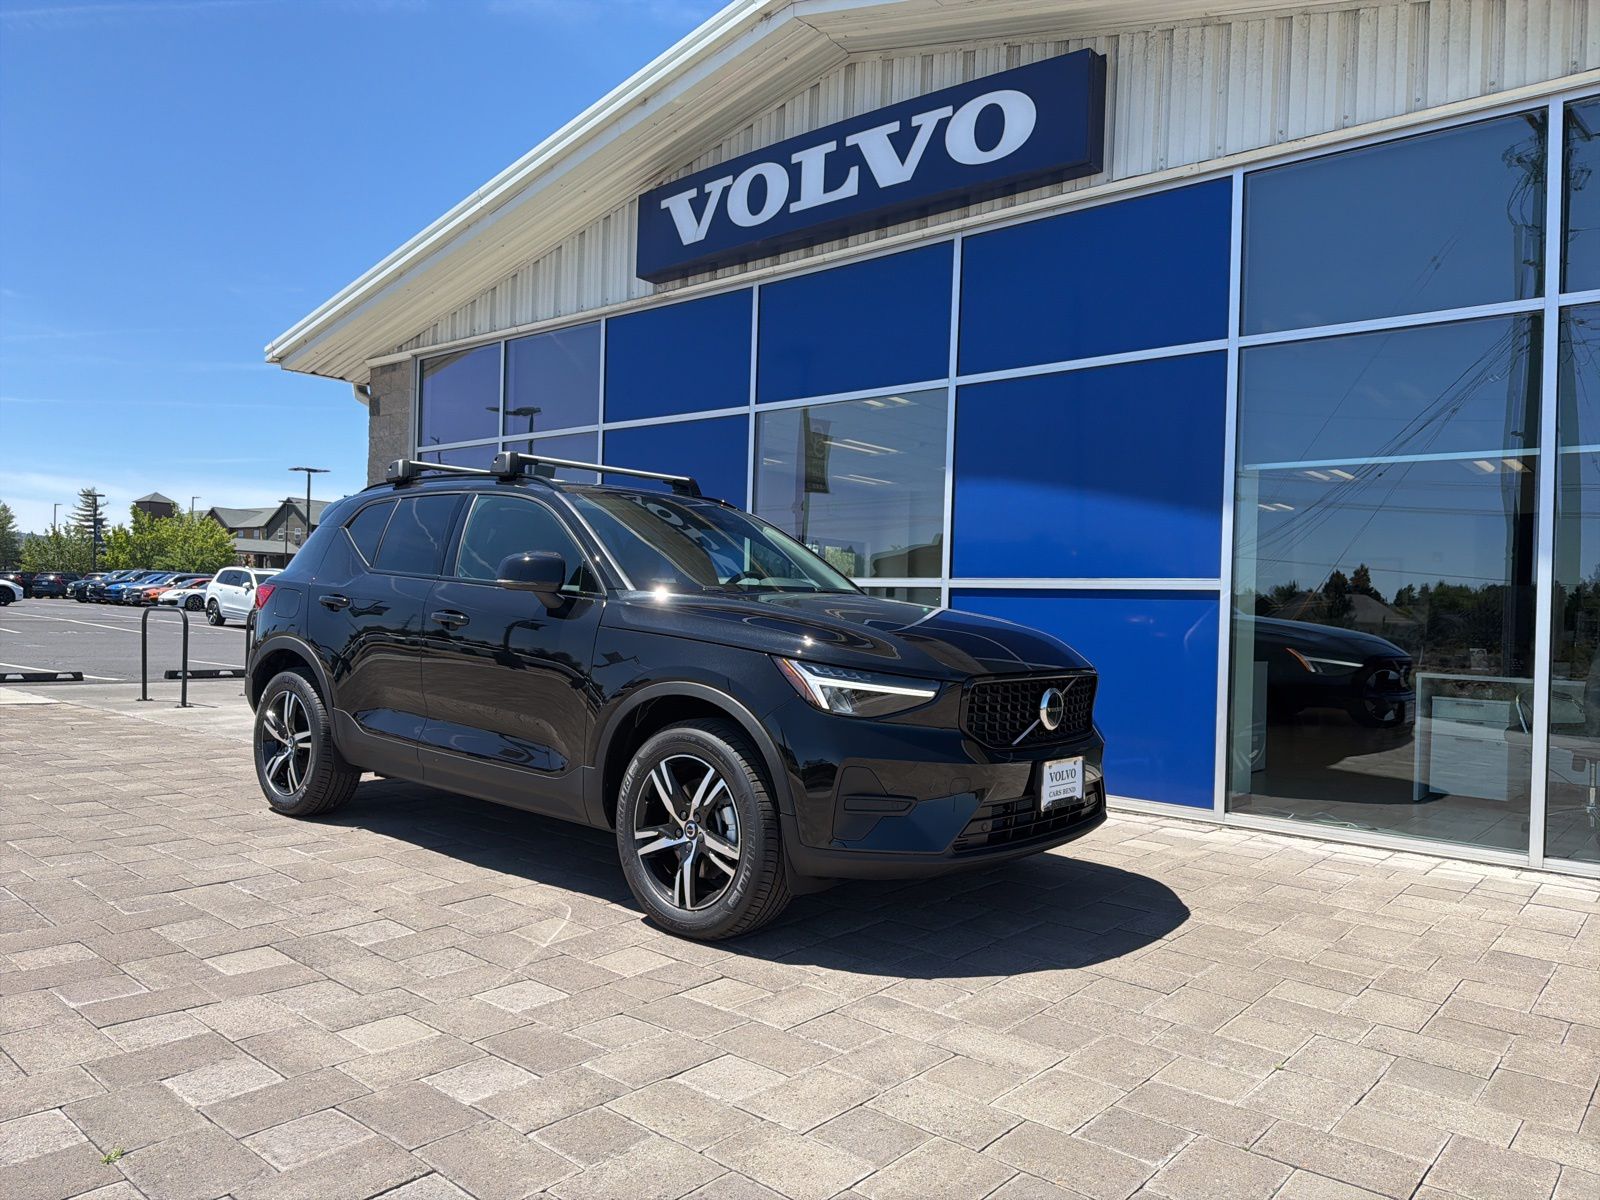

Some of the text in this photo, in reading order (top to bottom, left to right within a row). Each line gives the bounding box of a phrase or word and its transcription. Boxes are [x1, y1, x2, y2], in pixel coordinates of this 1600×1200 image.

[660, 89, 1037, 246] VOLVO
[1049, 768, 1076, 782] VOLVO
[1048, 786, 1076, 798] CARS BEND
